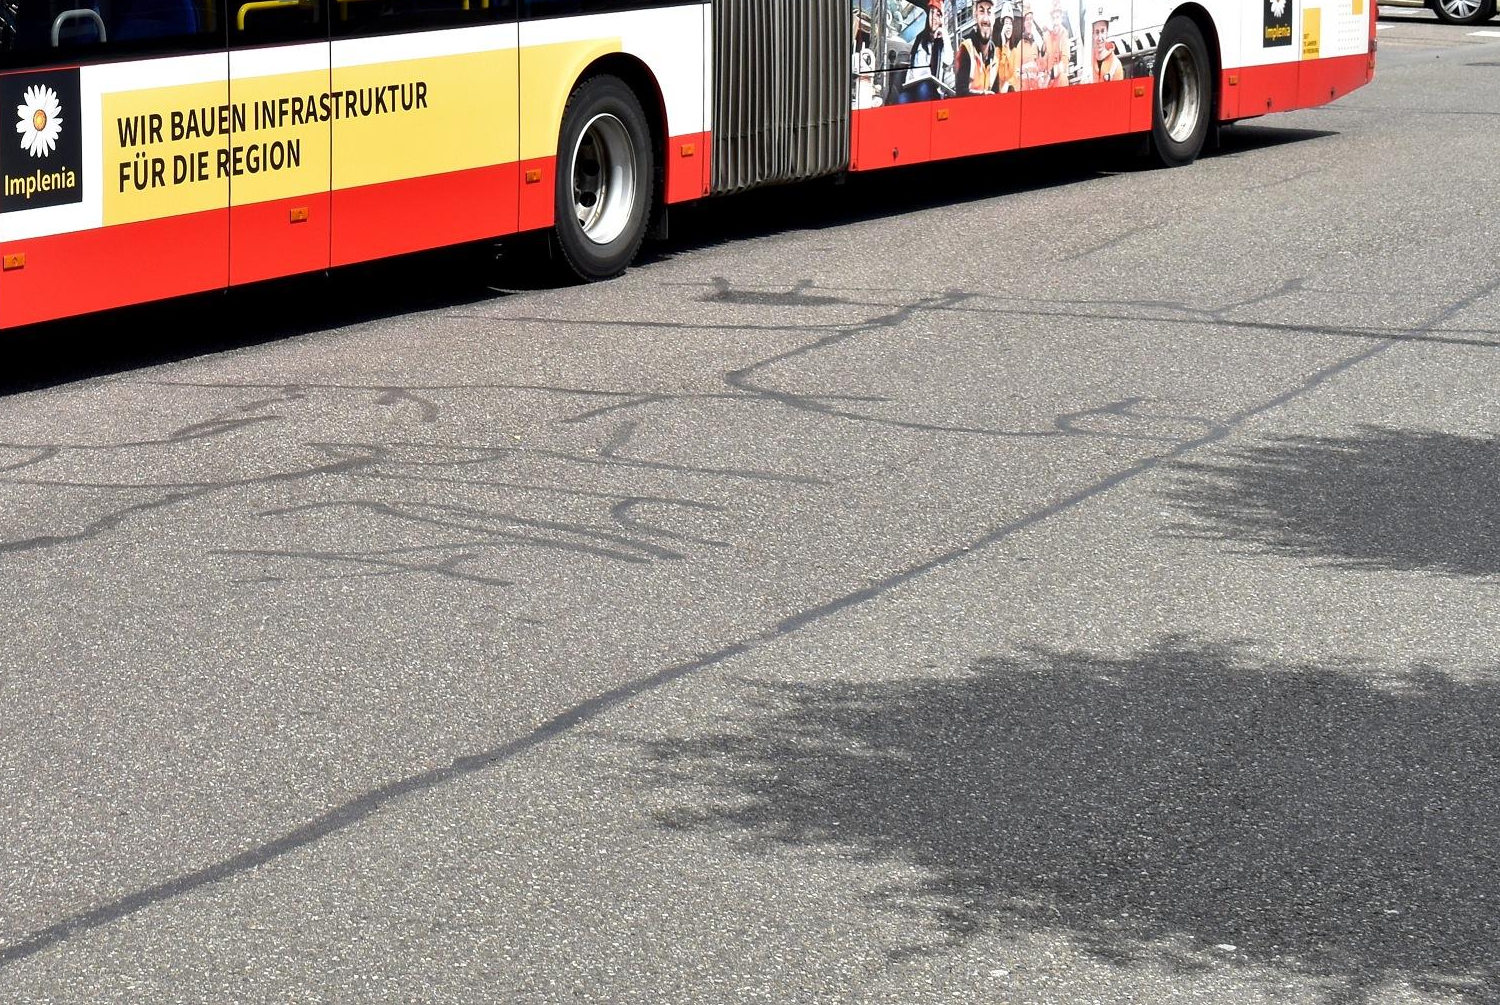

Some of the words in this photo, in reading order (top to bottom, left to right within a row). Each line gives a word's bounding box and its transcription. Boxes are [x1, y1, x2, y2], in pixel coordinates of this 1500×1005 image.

[1265, 24, 1291, 40] Implenia
[117, 113, 164, 148] WIR
[171, 103, 247, 142] BAUEN
[254, 81, 429, 131] INFRASTRUKTUR
[4, 167, 76, 199] Implenia
[118, 152, 166, 193] FÜR
[173, 149, 209, 184] DIE
[216, 139, 301, 178] REGION
